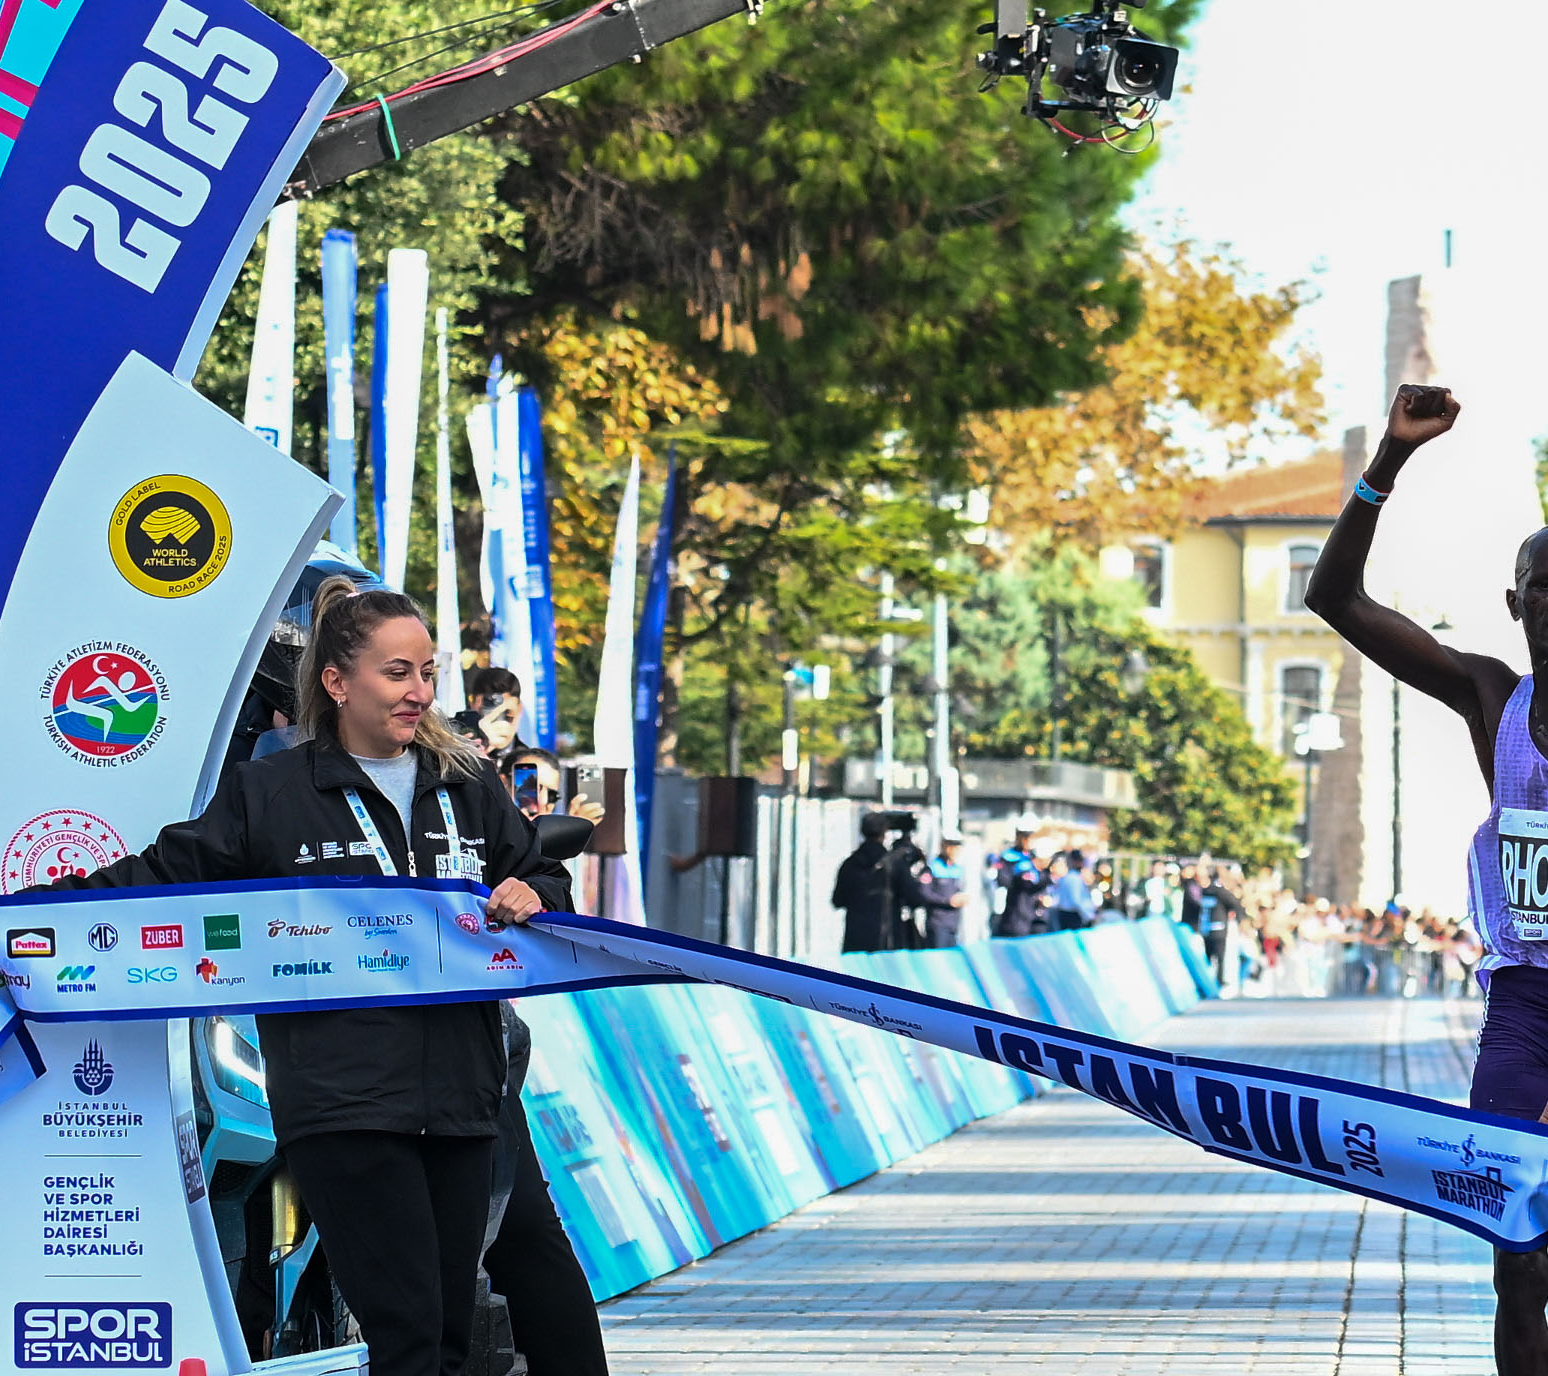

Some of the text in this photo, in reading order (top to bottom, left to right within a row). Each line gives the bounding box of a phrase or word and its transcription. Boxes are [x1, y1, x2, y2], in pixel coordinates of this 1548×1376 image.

[116, 482, 161, 525] GOLD LABEL
[152, 549, 188, 557] WORLD
[144, 558, 196, 566] ATHLETICS
[169, 536, 226, 592] ROAD RACE 2025
[39, 640, 170, 700] TÜRKİYE ATLETİZM FEDERASYONU
[43, 715, 167, 767] TURKISH ATHLETIC FEDERATION
[348, 914, 413, 927] CELENES
[286, 924, 333, 936] Tchibo
[128, 967, 177, 983] SKG
[57, 983, 96, 992] METRO FM
[59, 1102, 127, 1110] İSTANBUL
[43, 1112, 143, 1127] BÜYÜKŞEHİR
[59, 1128, 128, 1137] BELEDİYESİ
[1343, 1121, 1385, 1177] 2025
[44, 1174, 115, 1190] GENÇLİK
[44, 1193, 113, 1205] VE SPOR
[1437, 1187, 1505, 1222] MARATHON
[44, 1208, 139, 1221] HİZMETLERİ
[44, 1224, 107, 1238] DAİRESİ
[44, 1241, 143, 1257] BAŞKANLIĞI
[24, 1309, 162, 1339] SPOR
